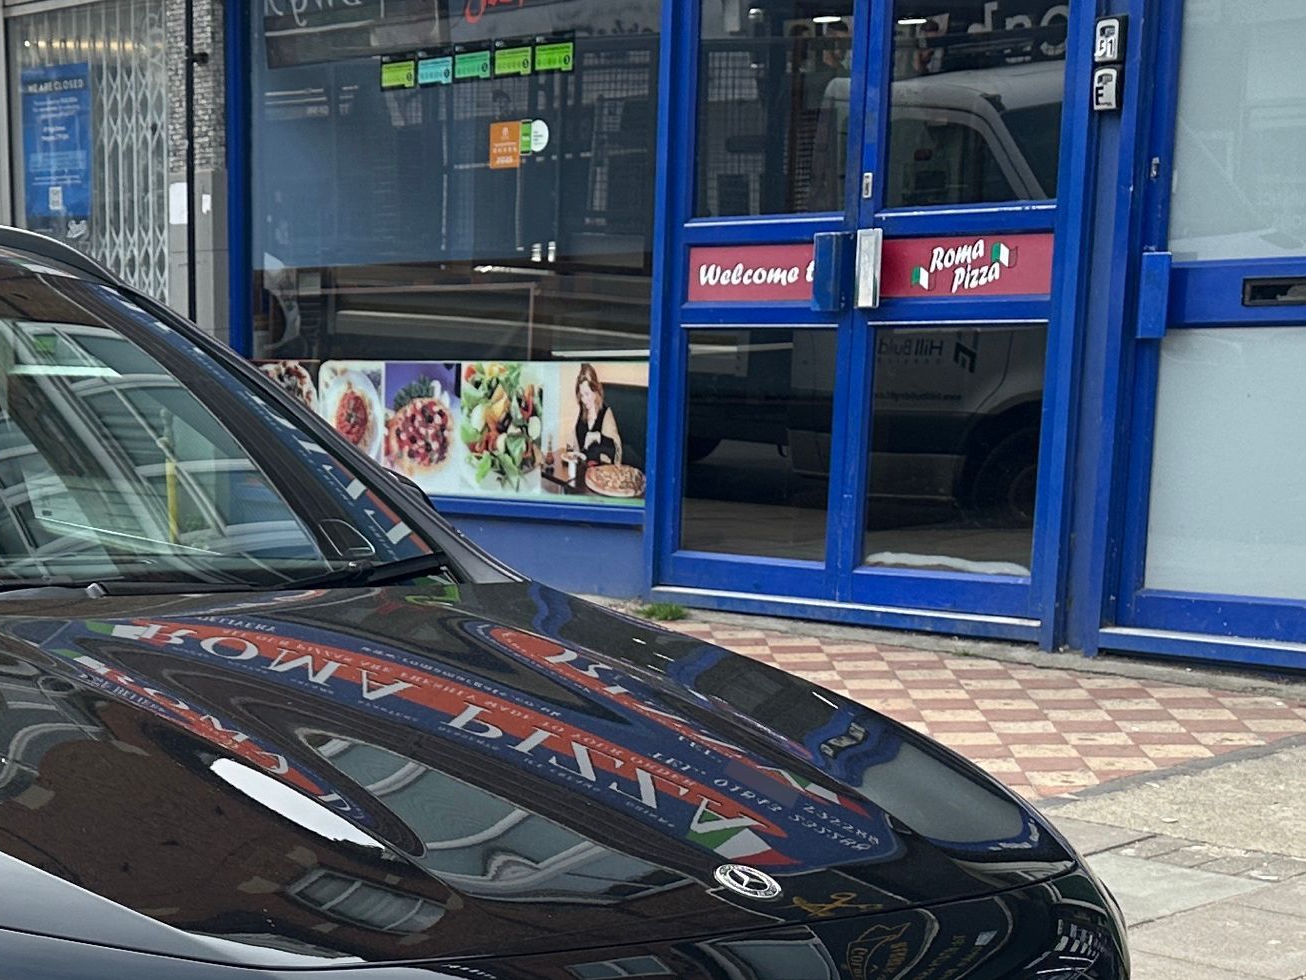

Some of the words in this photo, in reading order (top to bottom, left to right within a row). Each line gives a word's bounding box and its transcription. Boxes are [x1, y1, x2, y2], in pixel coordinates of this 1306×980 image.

[930, 239, 985, 272] Roma
[699, 263, 799, 286] Welcome
[952, 261, 1000, 294] Pizza
